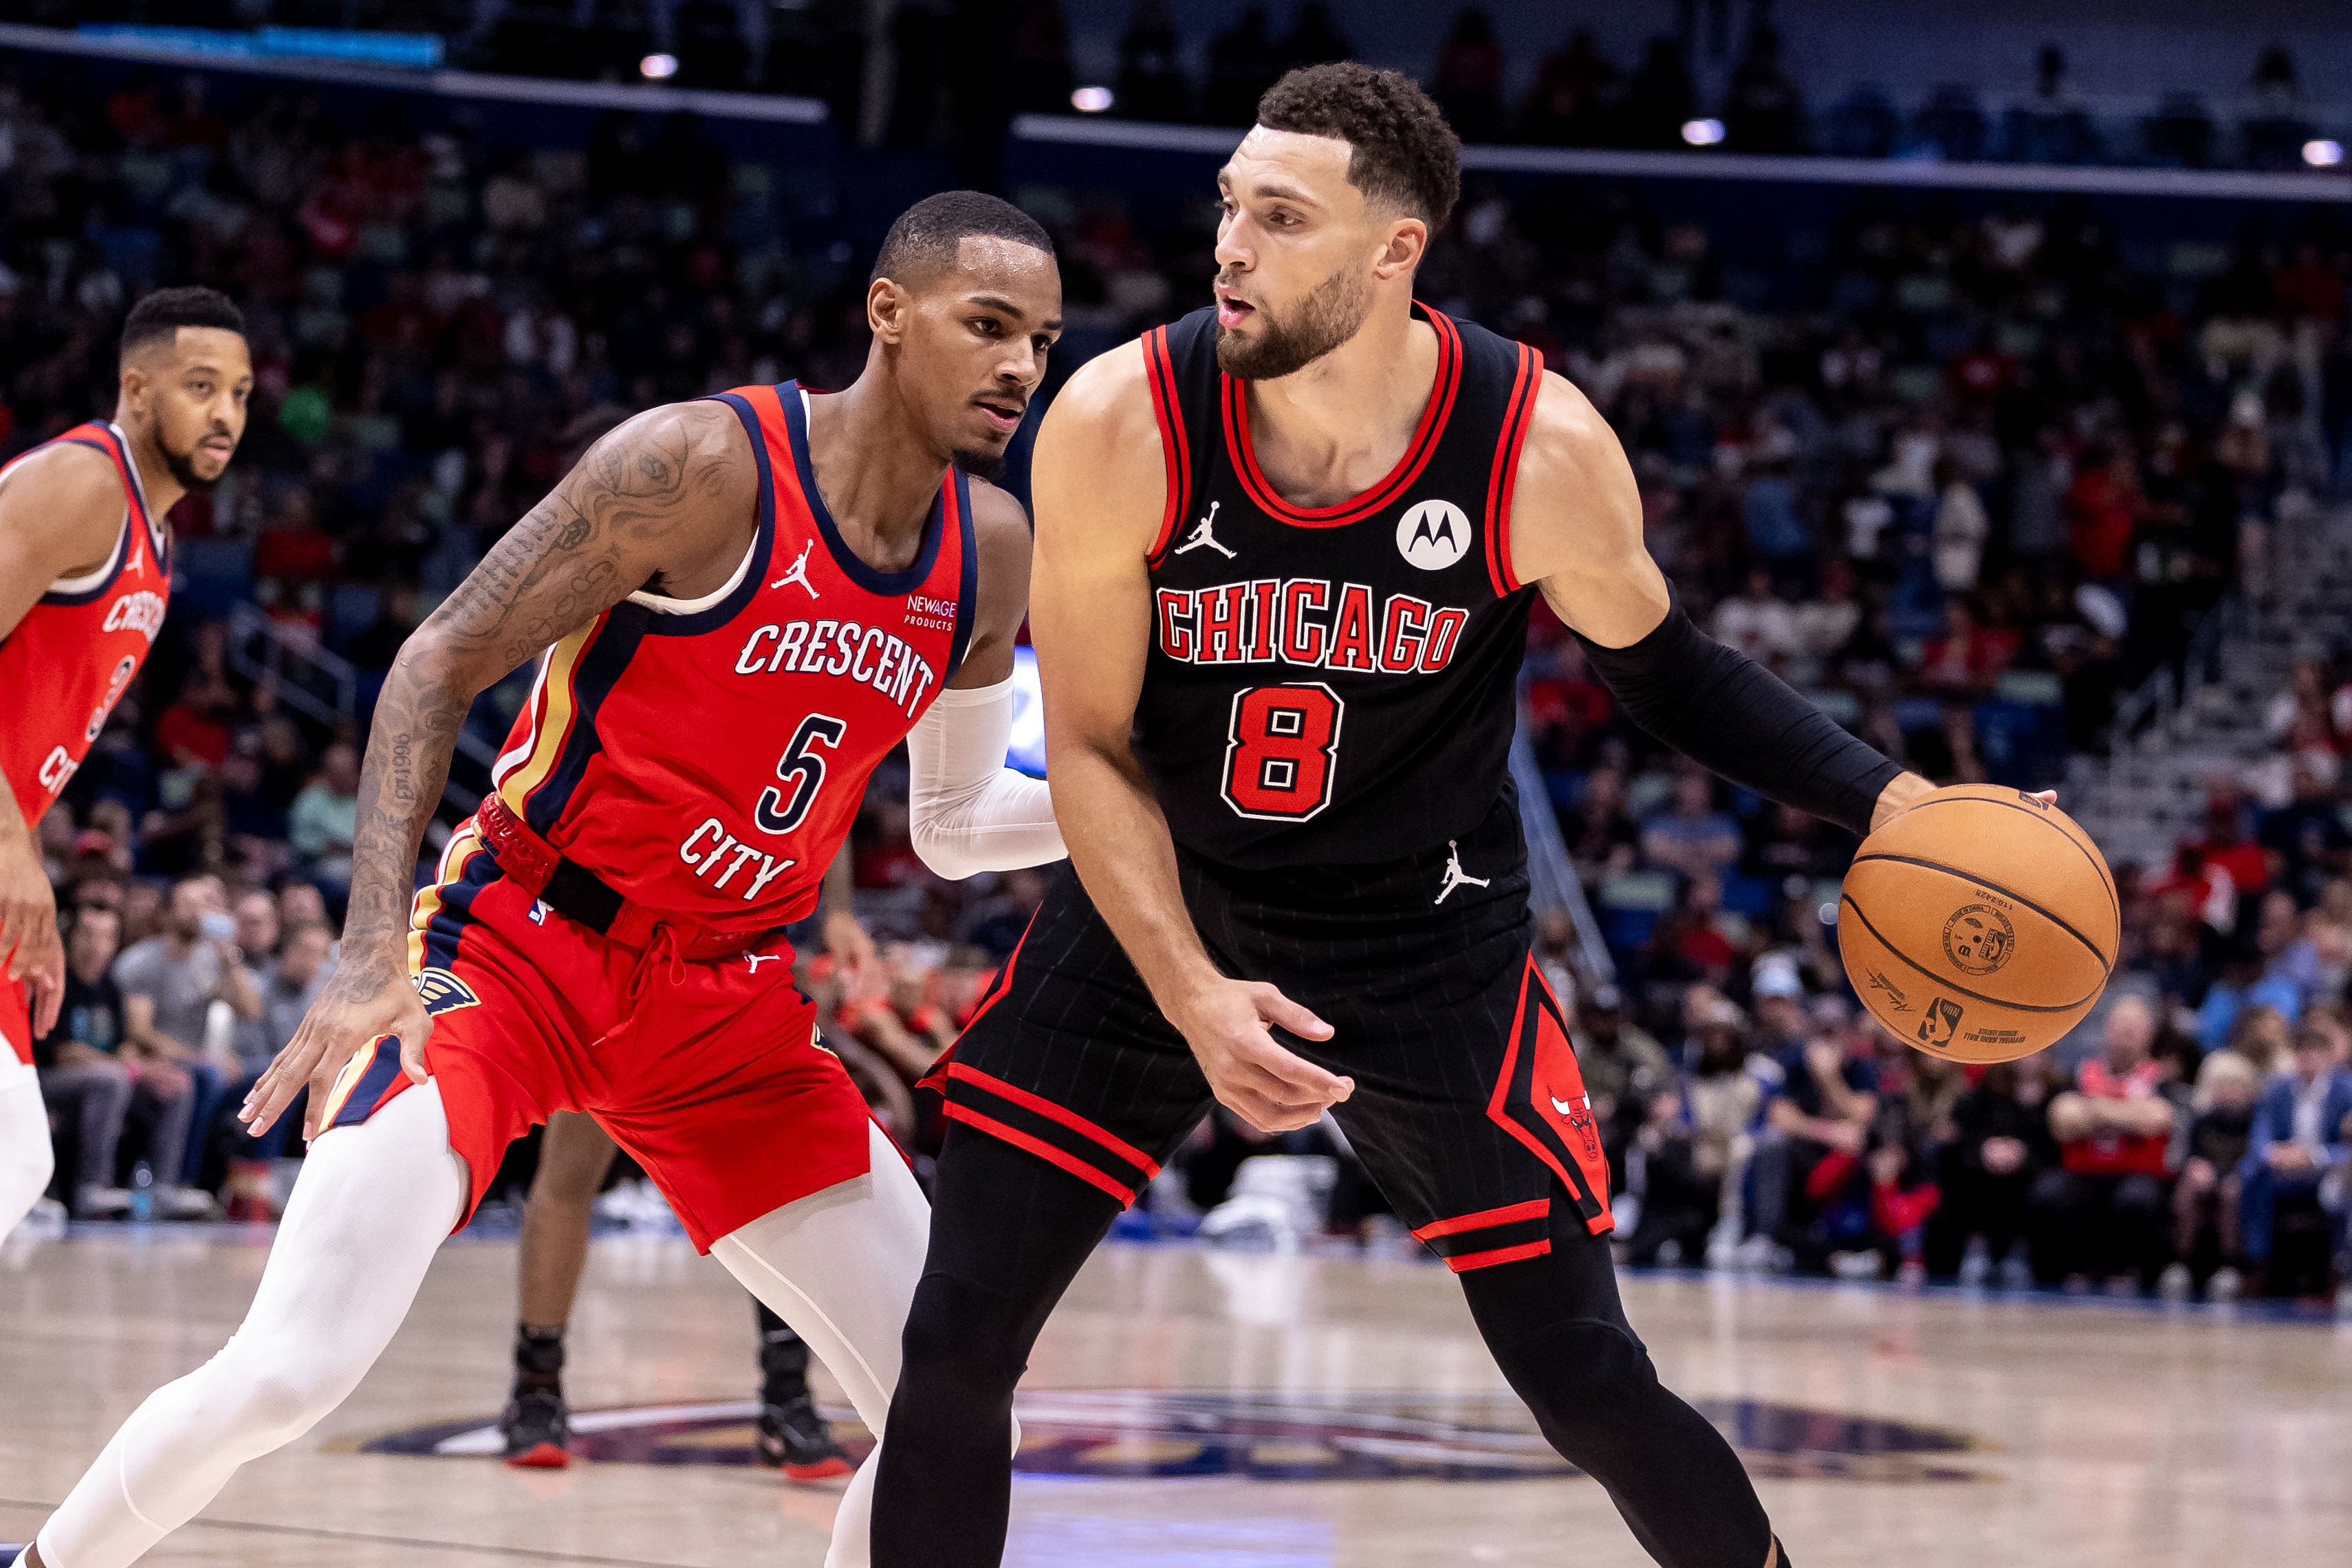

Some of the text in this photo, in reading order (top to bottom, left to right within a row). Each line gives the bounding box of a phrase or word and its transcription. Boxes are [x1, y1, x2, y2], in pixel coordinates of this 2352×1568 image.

[734, 618, 935, 720] CRESCENT
[904, 614, 952, 631] PRODUCTS
[1156, 578, 1470, 674] CHICAGO
[754, 712, 847, 835] 5
[1220, 682, 1344, 823] 8
[679, 817, 798, 902] CITY
